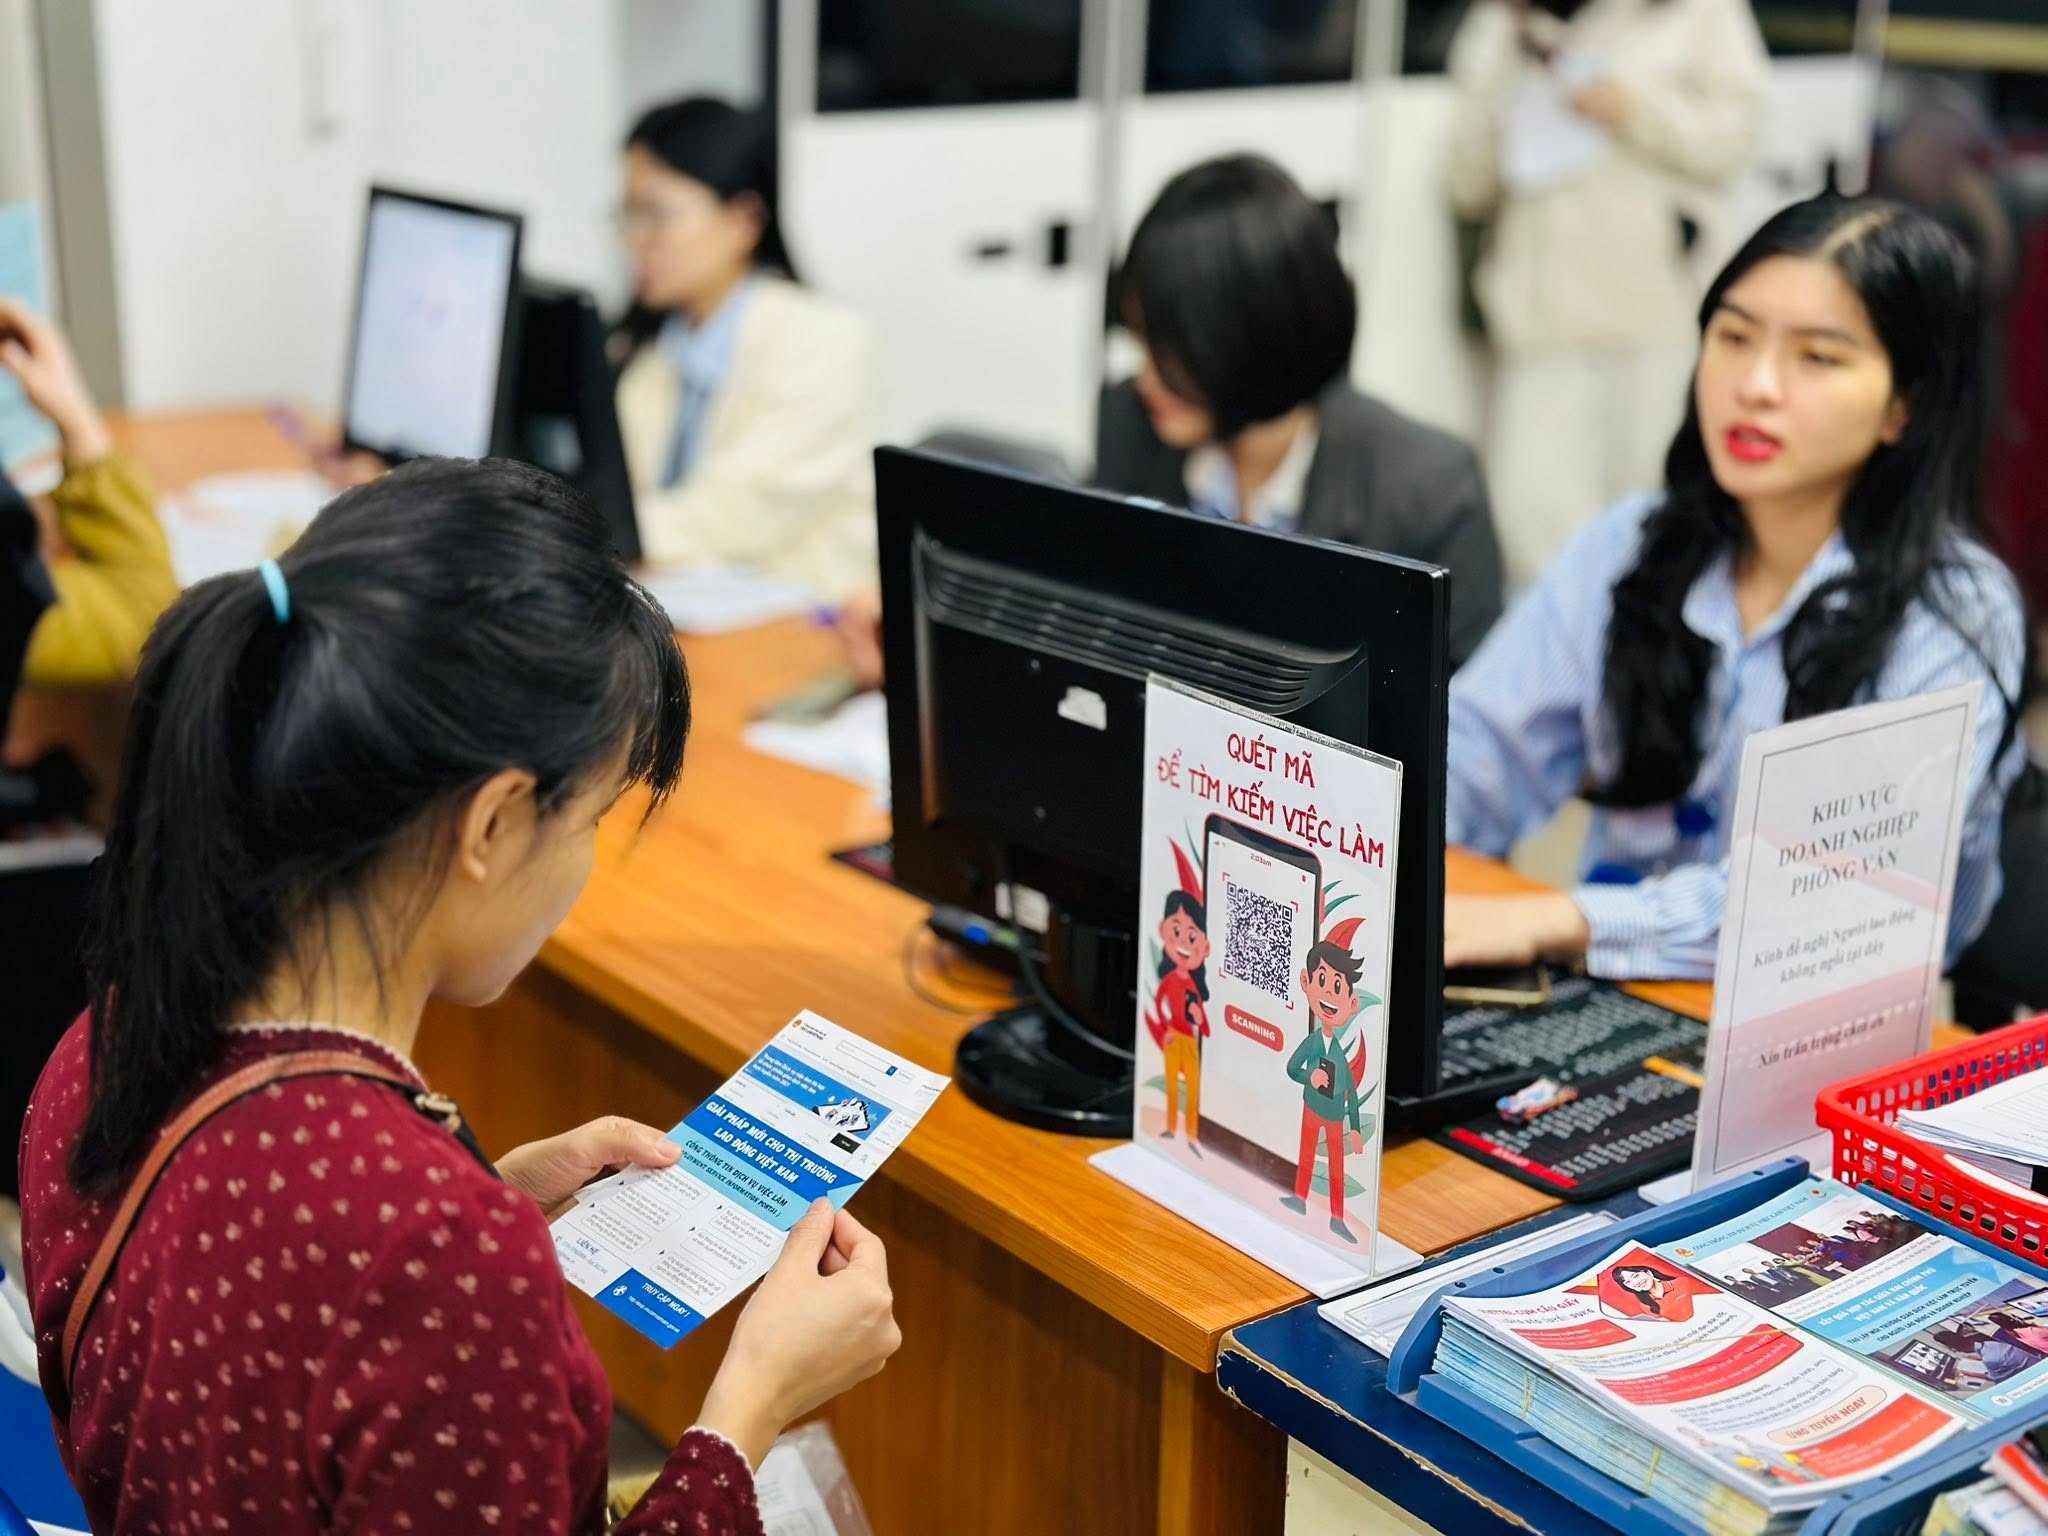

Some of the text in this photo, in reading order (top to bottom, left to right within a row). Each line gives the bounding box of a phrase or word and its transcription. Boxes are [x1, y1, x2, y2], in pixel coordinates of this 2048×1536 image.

[1227, 733, 1315, 788] QUÉT MÃ
[1156, 748, 1384, 868] ĐỂ TÌM KIẾM VIỆC LÀM
[1812, 783, 1897, 825] KHU VỰC
[1250, 853, 1272, 867] 2:03am
[1779, 810, 1919, 867] DOANH NGHIỆP
[1231, 1013, 1276, 1041] SCANNING
[705, 1100, 838, 1184] GIẢI PHÁP MỚI CHO THỊ TRƯỜNG
[713, 1127, 799, 1184] LAO ĐỘNG VIỆT NAM
[723, 1160, 734, 1172] TIN
[731, 1166, 749, 1184] DỊCH
[748, 1174, 759, 1188] VỤ
[756, 1180, 774, 1198] VIỆC
[771, 1191, 788, 1207] LÀM
[641, 1282, 660, 1296] TRUY
[656, 1292, 672, 1304] CẬP
[668, 1300, 688, 1316] NGAY
[1838, 1396, 1867, 1417] NGAY
